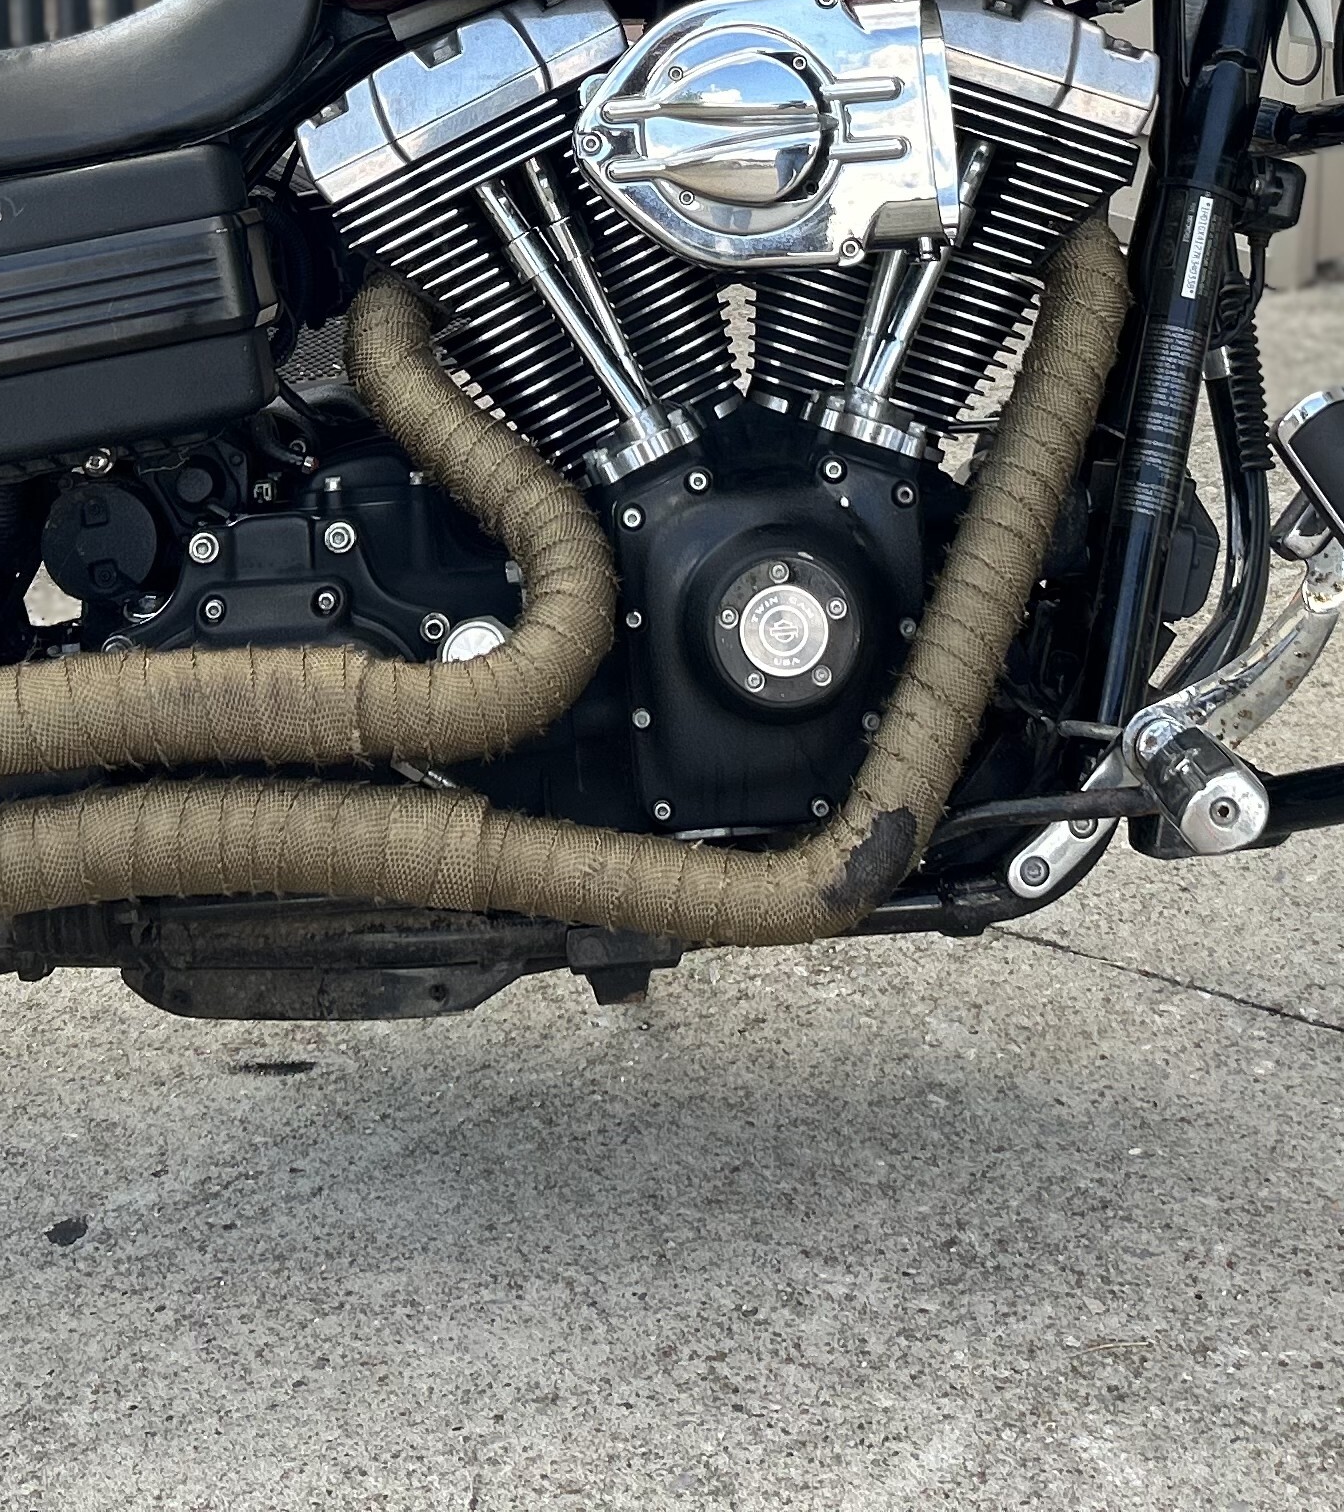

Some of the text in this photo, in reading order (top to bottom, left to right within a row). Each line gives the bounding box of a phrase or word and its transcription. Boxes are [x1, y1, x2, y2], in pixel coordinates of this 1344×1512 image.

[751, 595, 815, 623] TWIN CAM
[773, 657, 801, 666] USA
